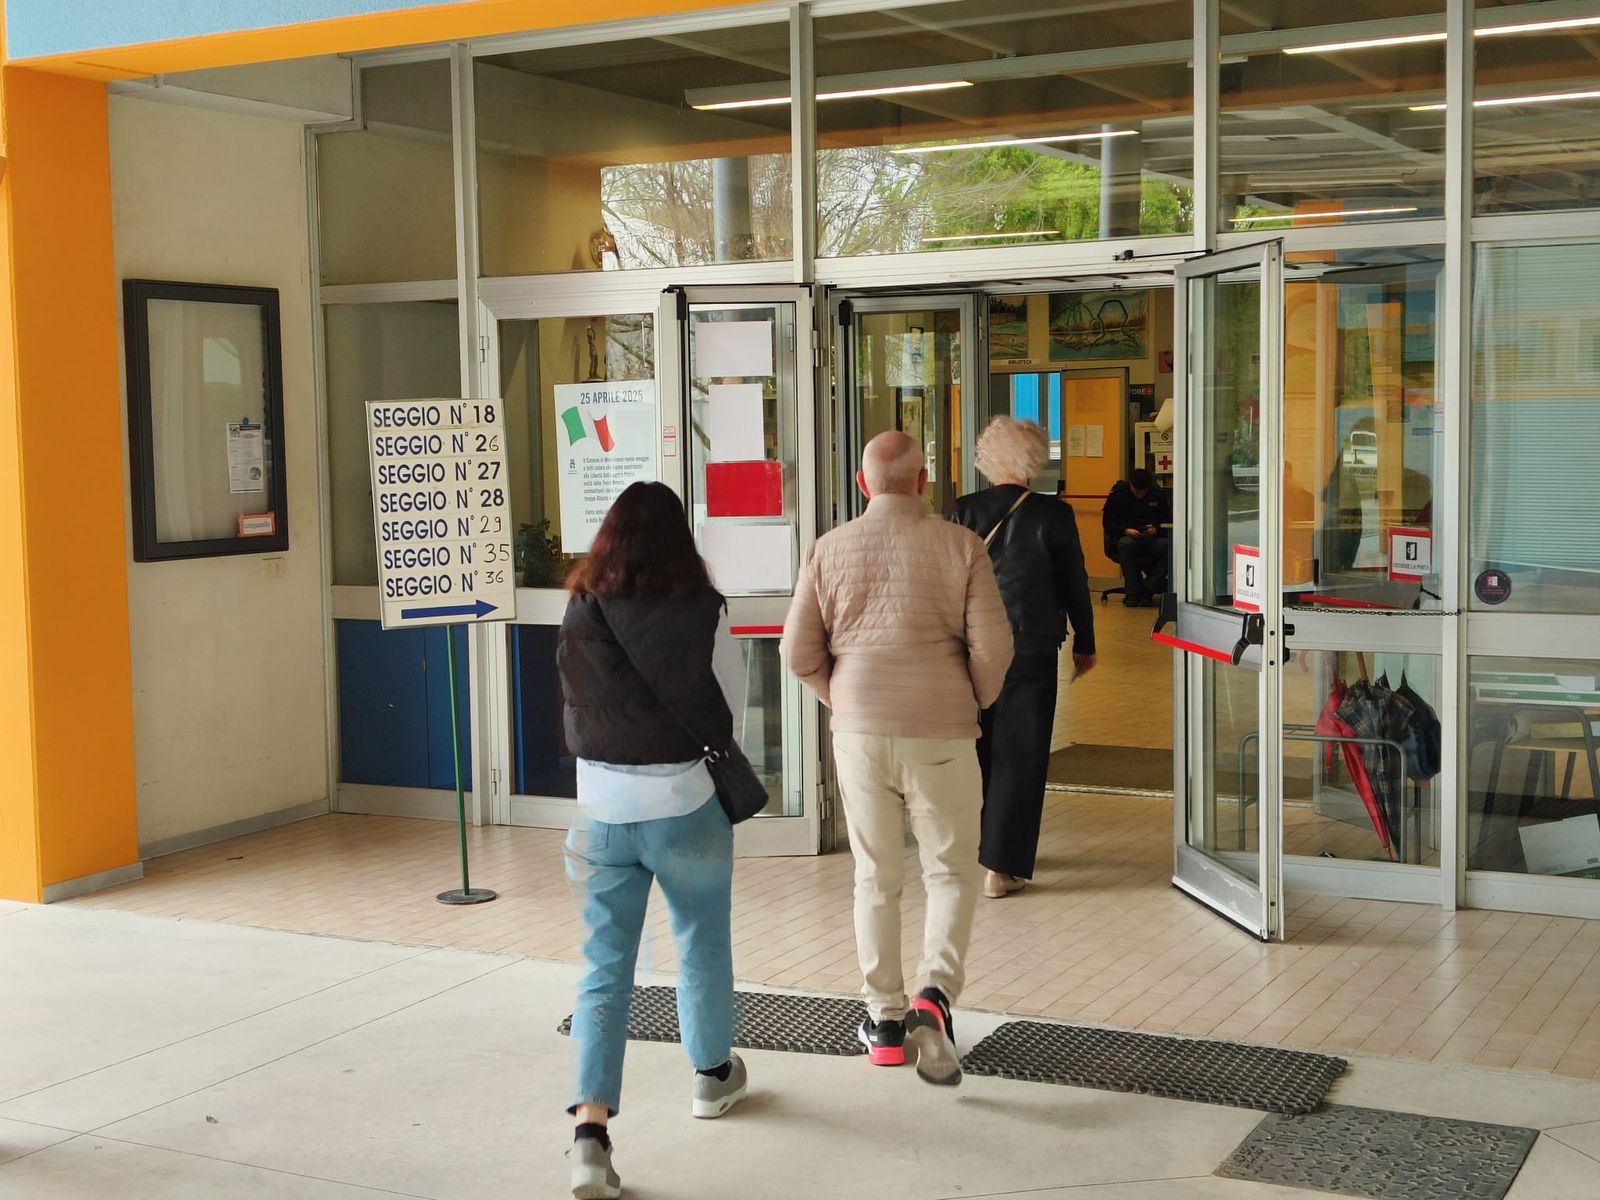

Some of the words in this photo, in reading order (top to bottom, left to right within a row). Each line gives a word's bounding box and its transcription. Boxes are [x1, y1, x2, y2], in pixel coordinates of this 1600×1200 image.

[580, 392, 591, 405] 25
[592, 391, 621, 404] APRILE
[622, 389, 643, 403] 2025
[374, 406, 441, 428] SEGGIO
[451, 402, 467, 424] N°
[474, 404, 496, 424] 18
[375, 434, 442, 457] SEGGIO
[452, 432, 469, 453] N°
[475, 434, 499, 452] 26
[378, 463, 446, 485] SEGGIO
[455, 460, 472, 481] N°
[477, 461, 501, 480] 27
[380, 491, 447, 513] SEGGIO
[456, 487, 473, 509] N°
[480, 488, 505, 507] 28
[382, 518, 448, 541] SEGGIO
[458, 515, 475, 537] N°
[480, 515, 502, 534] 29
[384, 546, 451, 570] SEGGIO
[460, 542, 477, 564] N°
[483, 543, 510, 563] 35
[386, 574, 452, 598] SEGGIO
[462, 570, 478, 592] N°
[485, 570, 504, 584] 36
